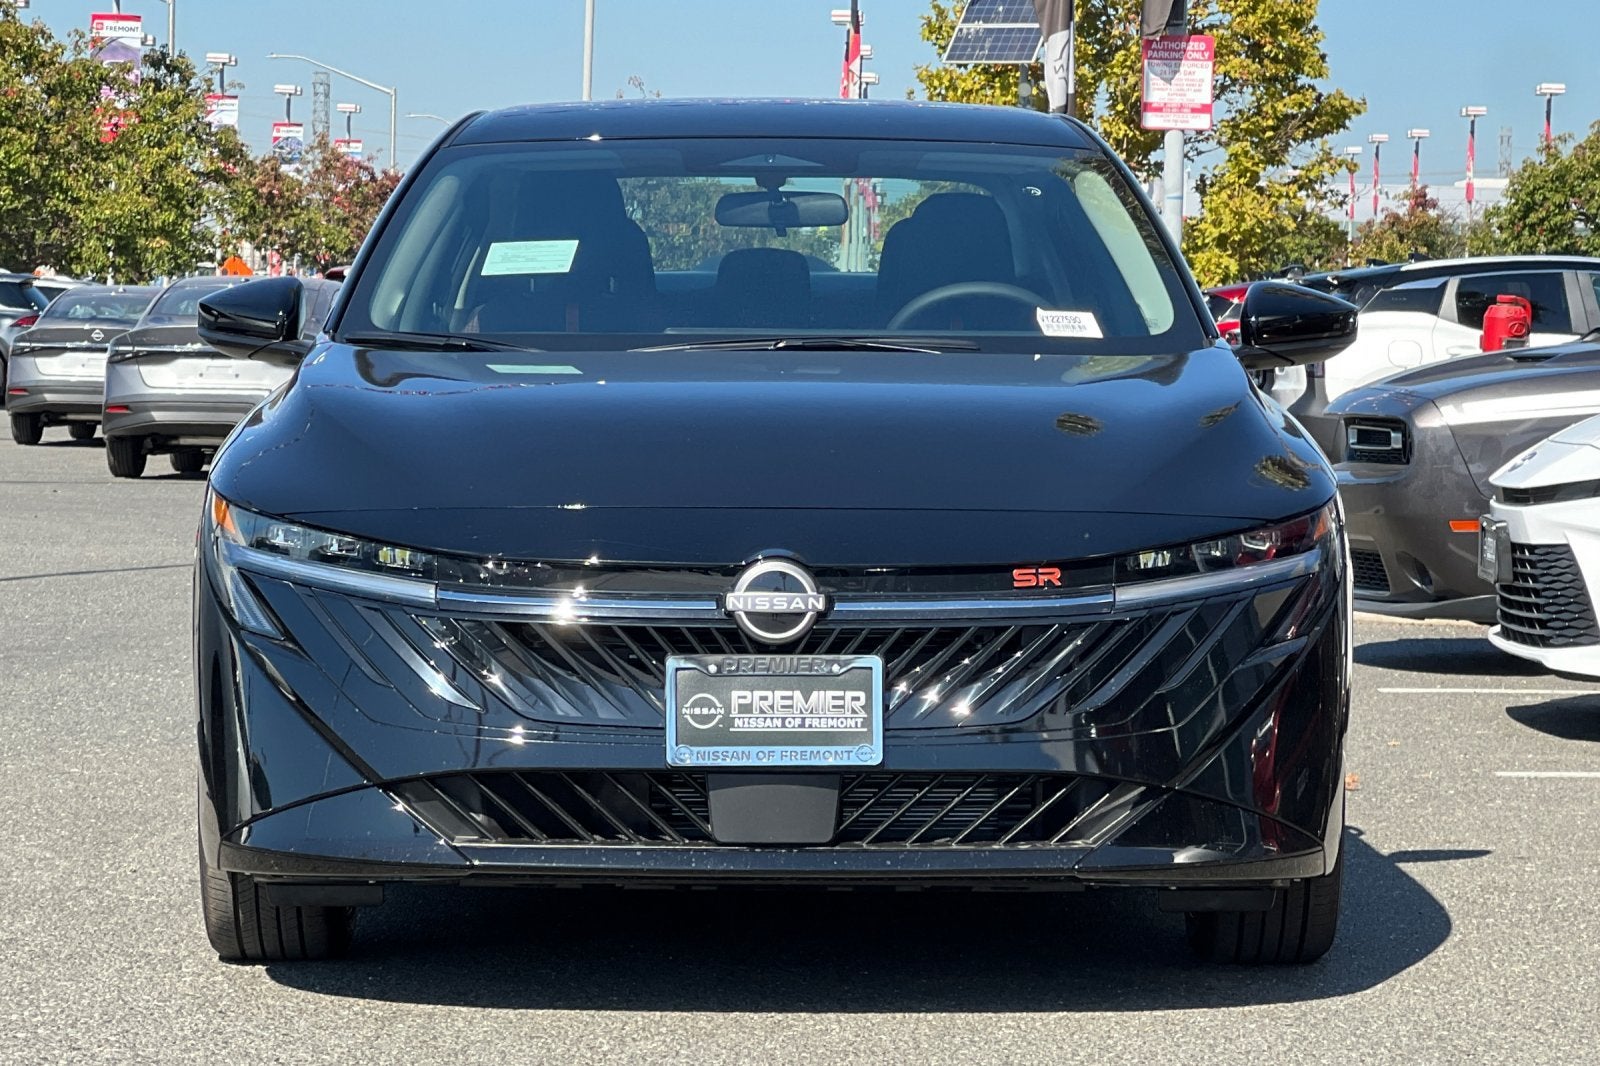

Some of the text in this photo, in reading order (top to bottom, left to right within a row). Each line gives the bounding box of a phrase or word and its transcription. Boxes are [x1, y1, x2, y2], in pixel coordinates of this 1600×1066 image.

[105, 25, 139, 33] FREMONT
[1151, 41, 1206, 51] AUTHORIZED
[1147, 50, 1210, 60] PARKING ONLY
[1012, 567, 1062, 587] SR
[729, 596, 823, 610] NISSAN
[721, 657, 826, 674] PREMIER
[731, 690, 866, 715] PREMIER
[682, 707, 724, 715] NISSAN
[734, 717, 863, 728] NISSAN OF FREMONT
[696, 750, 750, 761] NISSAN
[756, 750, 775, 761] OF
[780, 749, 853, 761] FREMONT
